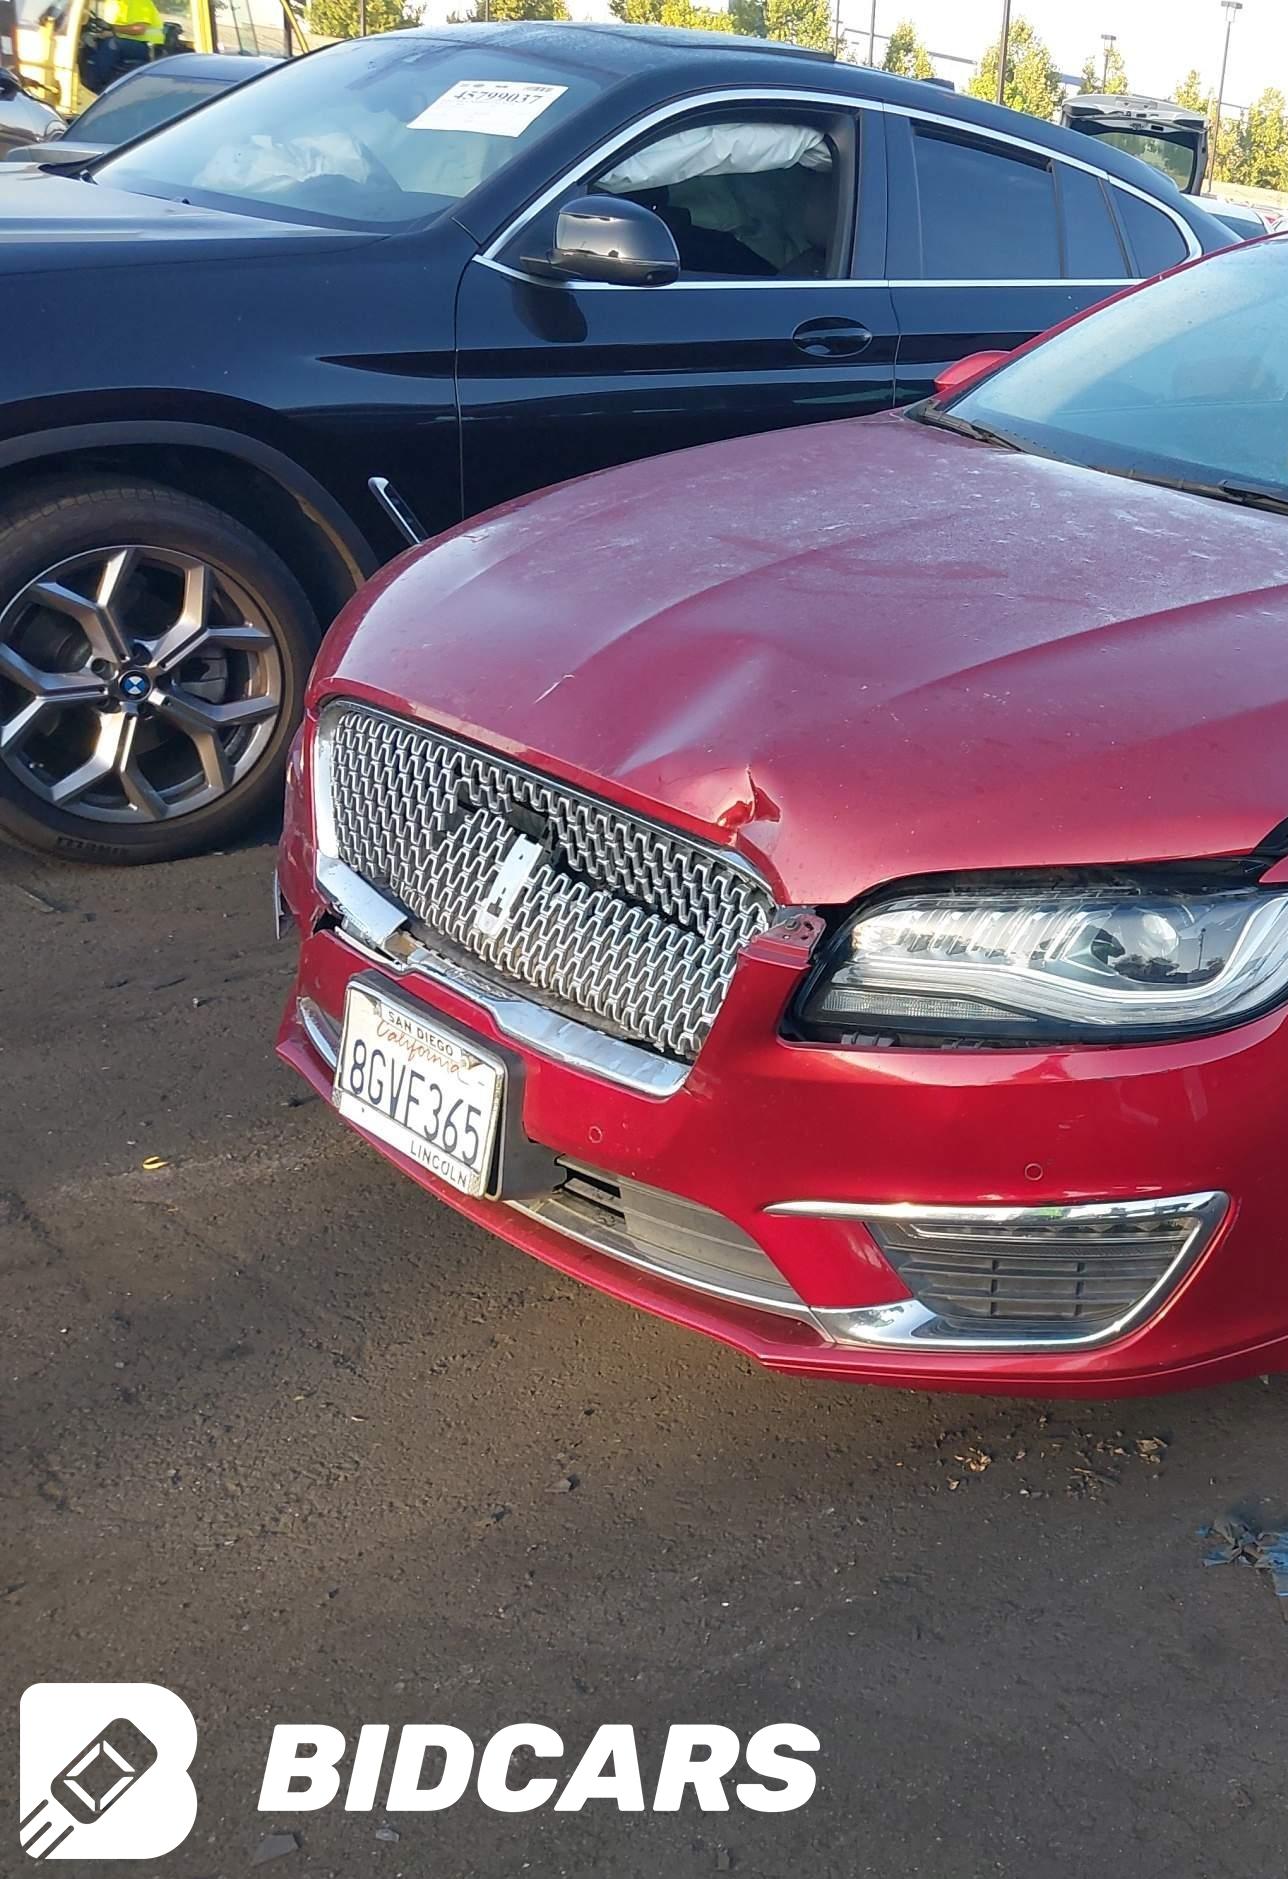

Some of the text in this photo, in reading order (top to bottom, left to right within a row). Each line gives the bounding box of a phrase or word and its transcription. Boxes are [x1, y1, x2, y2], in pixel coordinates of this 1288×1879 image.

[377, 1020, 459, 1072] California
[388, 1011, 453, 1056] SAN DIEGO
[350, 1039, 482, 1166] 8GVF365
[410, 1140, 467, 1187] LINCOLN
